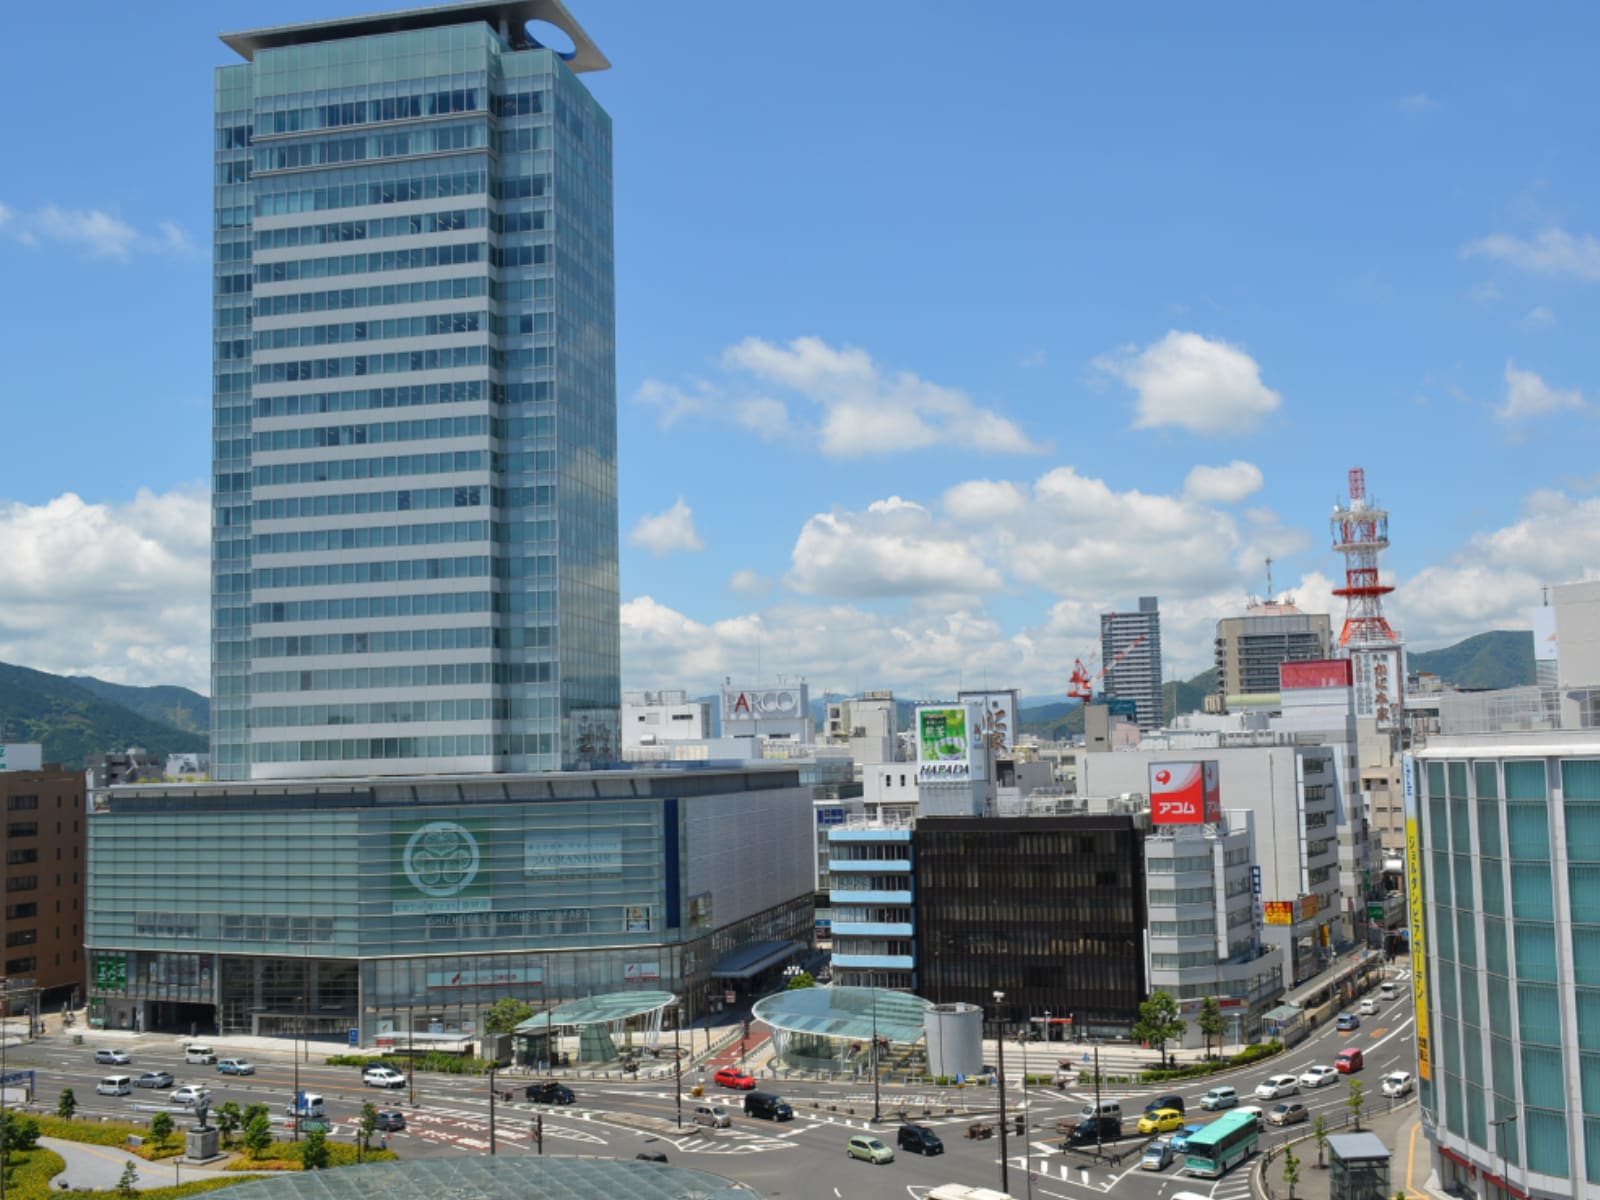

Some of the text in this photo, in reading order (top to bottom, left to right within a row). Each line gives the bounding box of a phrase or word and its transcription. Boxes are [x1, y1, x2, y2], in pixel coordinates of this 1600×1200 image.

[1374, 663, 1390, 721] かに本家
[724, 691, 797, 713] PARCO
[920, 764, 969, 776] HARADA
[1159, 801, 1196, 815] アコム
